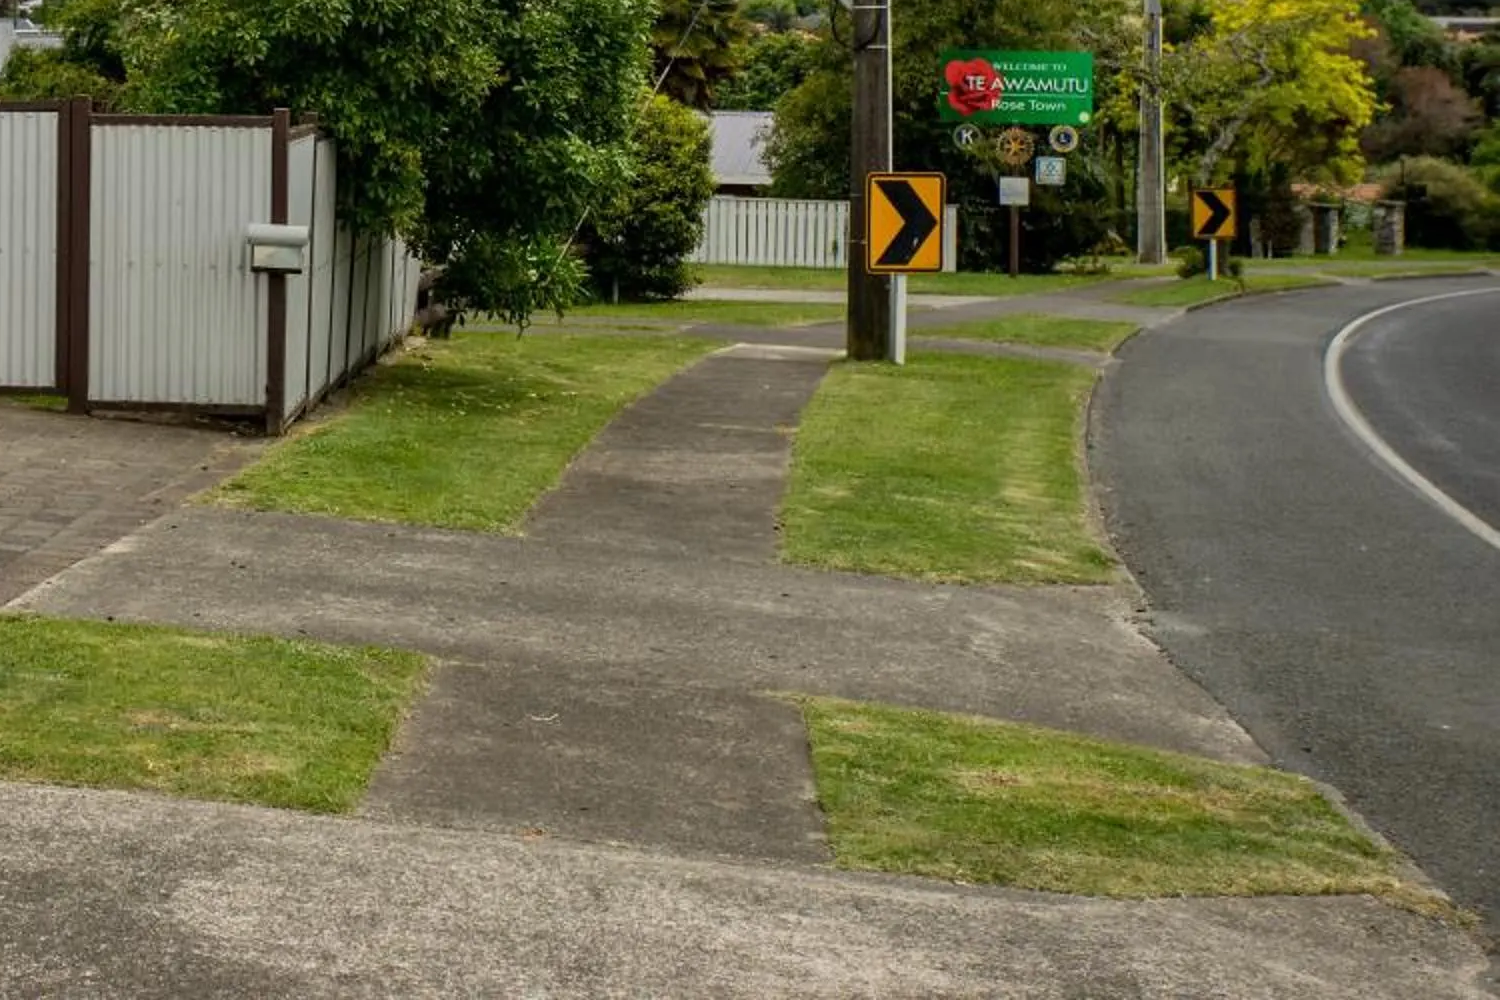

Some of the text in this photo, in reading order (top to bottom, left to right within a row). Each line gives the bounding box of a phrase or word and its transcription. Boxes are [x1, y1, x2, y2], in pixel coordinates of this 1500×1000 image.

[992, 62, 1067, 72] WELCOME TO
[966, 75, 1089, 93] TE AWAMUTU
[991, 99, 1067, 112] Rose Town
